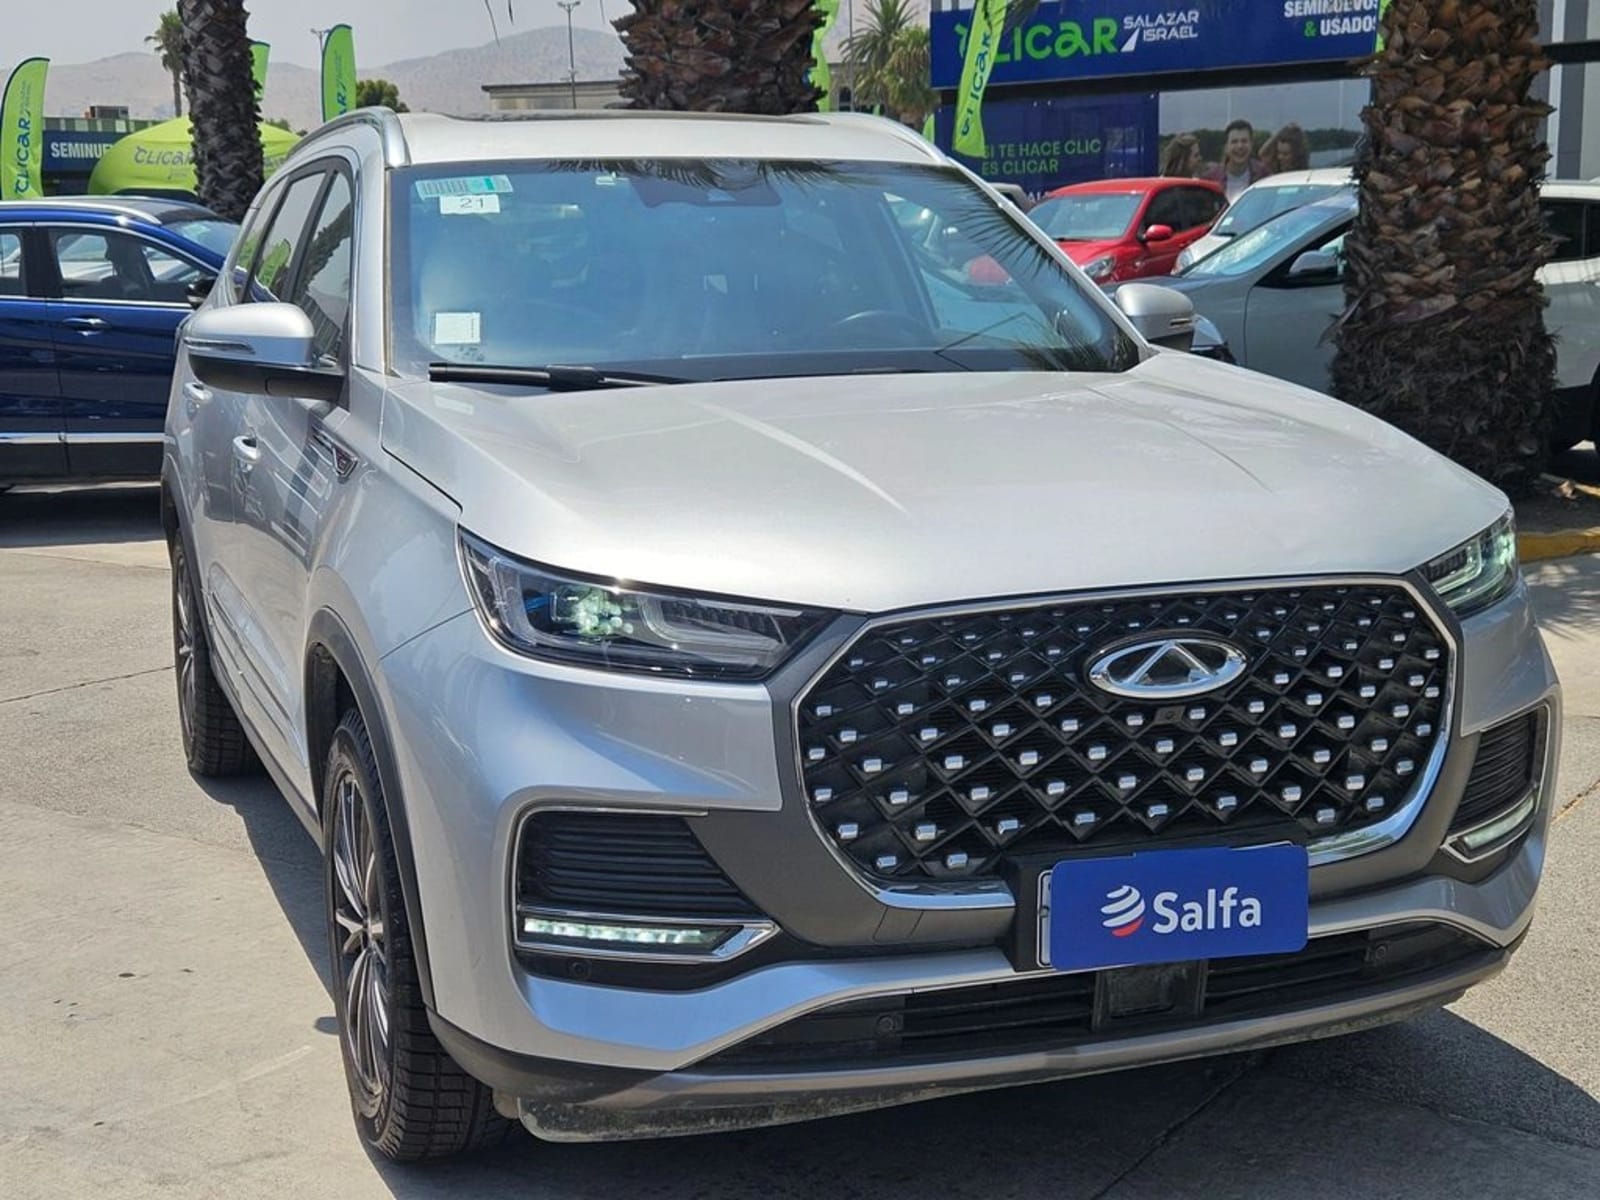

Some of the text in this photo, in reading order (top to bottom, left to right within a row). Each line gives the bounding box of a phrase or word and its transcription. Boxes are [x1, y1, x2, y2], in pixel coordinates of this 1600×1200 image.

[1123, 10, 1199, 29] SALAZAR
[1304, 20, 1316, 37] &
[1143, 25, 1198, 42] ISRAEL
[15, 117, 31, 194] CLICAR
[999, 143, 1015, 159] TE
[1019, 141, 1061, 157] HACE
[1064, 138, 1101, 155] CLIC
[982, 158, 1059, 176] ES CLICAR
[1152, 887, 1261, 934] Salfa
